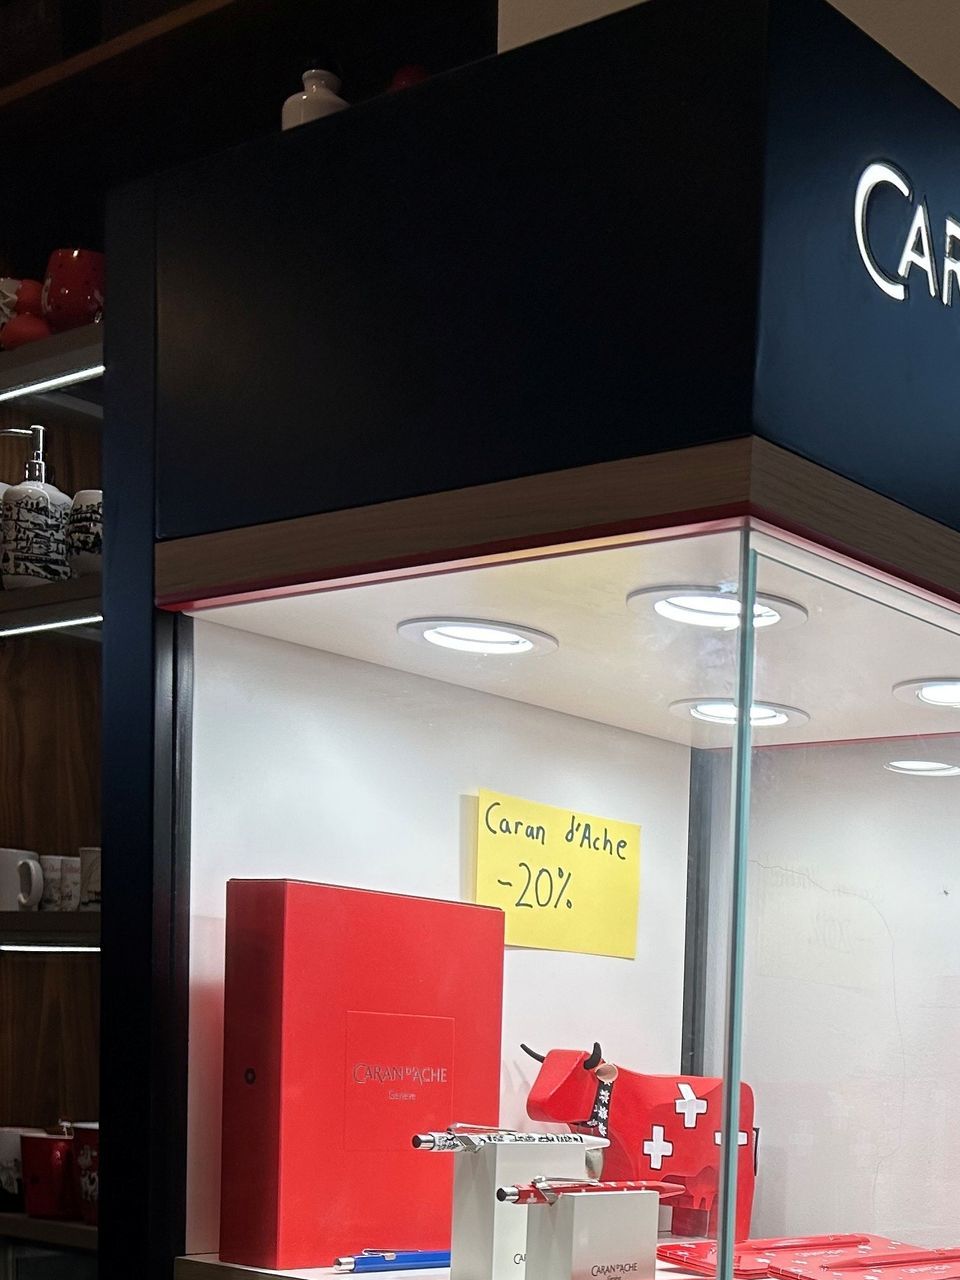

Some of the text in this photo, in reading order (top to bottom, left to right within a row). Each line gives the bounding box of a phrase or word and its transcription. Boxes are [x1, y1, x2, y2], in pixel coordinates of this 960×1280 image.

[485, 801, 628, 861] Caran d'Ache
[497, 862, 573, 909] -20%
